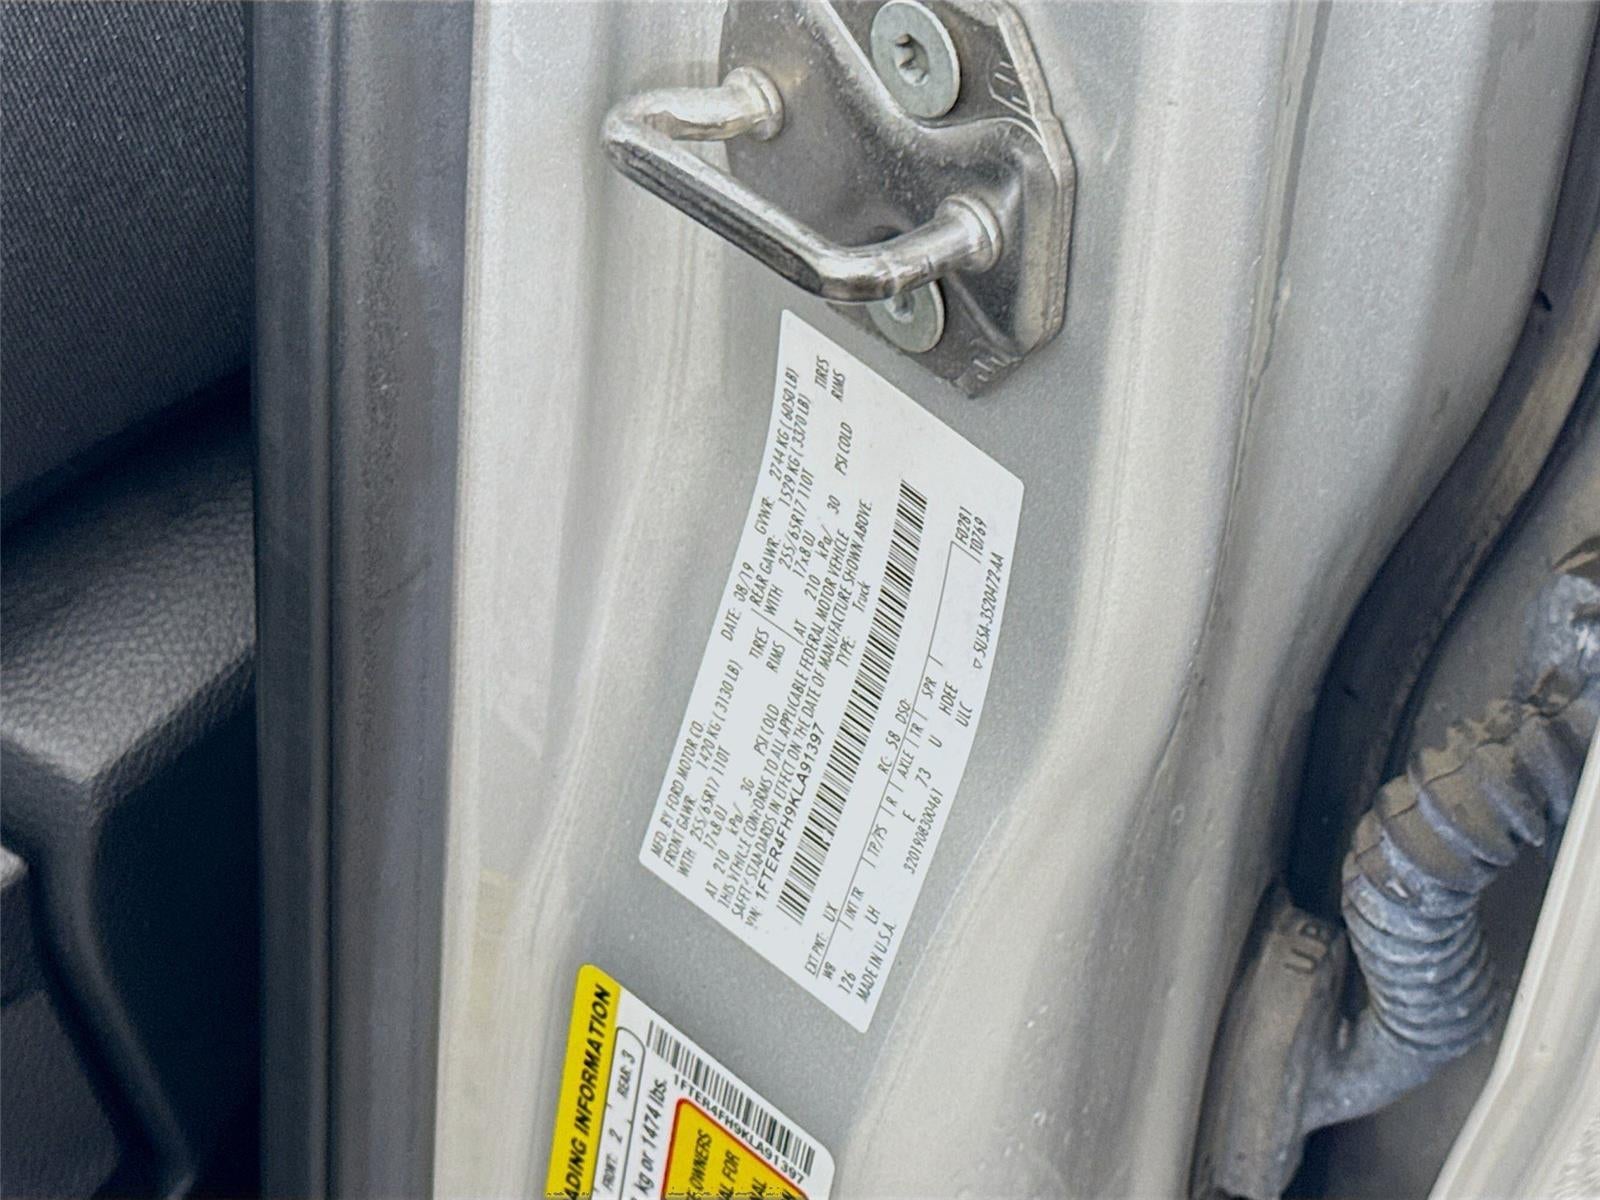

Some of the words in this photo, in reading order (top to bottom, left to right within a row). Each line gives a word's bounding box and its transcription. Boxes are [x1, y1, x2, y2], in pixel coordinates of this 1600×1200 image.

[830, 367, 845, 402] RIMS
[779, 386, 796, 422] 6050
[775, 426, 789, 449] KG
[791, 412, 808, 449] 3370
[837, 419, 853, 455] COLD
[768, 445, 786, 482] 2744
[785, 453, 800, 476] KG
[833, 452, 848, 475] PSI
[763, 582, 783, 618] WITH
[778, 498, 806, 570] 255/65R17
[796, 466, 814, 500] 110T
[813, 354, 828, 390] TIRES
[777, 472, 796, 508] 1529
[826, 493, 841, 515] 30
[755, 492, 776, 536] GVWR:
[852, 495, 872, 542] ABOVE.
[759, 531, 781, 576] GAWR:
[815, 523, 834, 560] kPa/
[827, 528, 849, 579] VEHICLE
[841, 538, 863, 587] SHOWN
[750, 573, 769, 608] REAR
[804, 572, 821, 601] 210
[814, 575, 837, 622] MOTOR
[720, 603, 741, 642] DATE:
[793, 618, 807, 638] AT
[818, 583, 852, 671] MANUFACTURE
[835, 631, 856, 669] TYPE:
[852, 576, 871, 613] Truck
[765, 638, 785, 673] RIMS
[797, 619, 824, 672] FEDERAL
[809, 665, 826, 688] OF
[920, 674, 937, 700] SPR
[759, 701, 780, 737] COLD
[775, 666, 809, 739] APPLICABLE
[799, 683, 820, 719] DATE
[688, 715, 705, 739] CO.
[753, 733, 769, 757] PSI
[791, 715, 809, 741] THE
[909, 720, 923, 739] TR
[677, 845, 696, 878] WITH
[689, 775, 719, 842] 255/65R17
[711, 743, 730, 777] 110T
[748, 625, 769, 661] TIRES
[677, 737, 698, 781] MOTOR
[768, 735, 786, 760] ALL
[784, 737, 801, 761] ON
[895, 746, 915, 779] AXLE
[663, 828, 685, 869] FRONT
[695, 736, 715, 770] 1420
[705, 718, 721, 739] KG
[714, 678, 734, 714] 3130
[763, 756, 779, 777] TO
[665, 778, 685, 813] FORD
[755, 721, 825, 902] 1FTER4FH9KLA91397
[767, 796, 781, 814] IN
[885, 794, 898, 806] R
[660, 809, 675, 829] BY
[837, 967, 856, 995] 126
[864, 903, 881, 925] LH
[902, 808, 916, 823] E
[914, 764, 932, 788] 73
[928, 733, 942, 749] U
[937, 679, 958, 716] HDEE
[744, 811, 777, 881] STANDARDS
[856, 965, 878, 1003] MADE
[868, 951, 883, 970] IN
[954, 699, 972, 729] ULC
[866, 821, 888, 858] TP/PS
[712, 847, 729, 875] 210
[704, 879, 719, 899] AT
[717, 878, 736, 909] THIS
[850, 884, 864, 902] TR
[844, 898, 859, 921] INT
[804, 952, 820, 976] EXT
[822, 900, 839, 924] UX
[574, 984, 611, 1135] INFORMATION
[609, 1128, 623, 1143] 2
[622, 1049, 636, 1064] 3
[650, 1079, 668, 1108] lbs.
[642, 1105, 661, 1147] 1474
[674, 1074, 804, 1184] 1FTER4FH9KLA91397
[641, 1155, 654, 1173] or
[690, 1129, 712, 1191] OWNERS
[722, 1149, 740, 1183] FOR
[634, 1170, 655, 1194] kg
